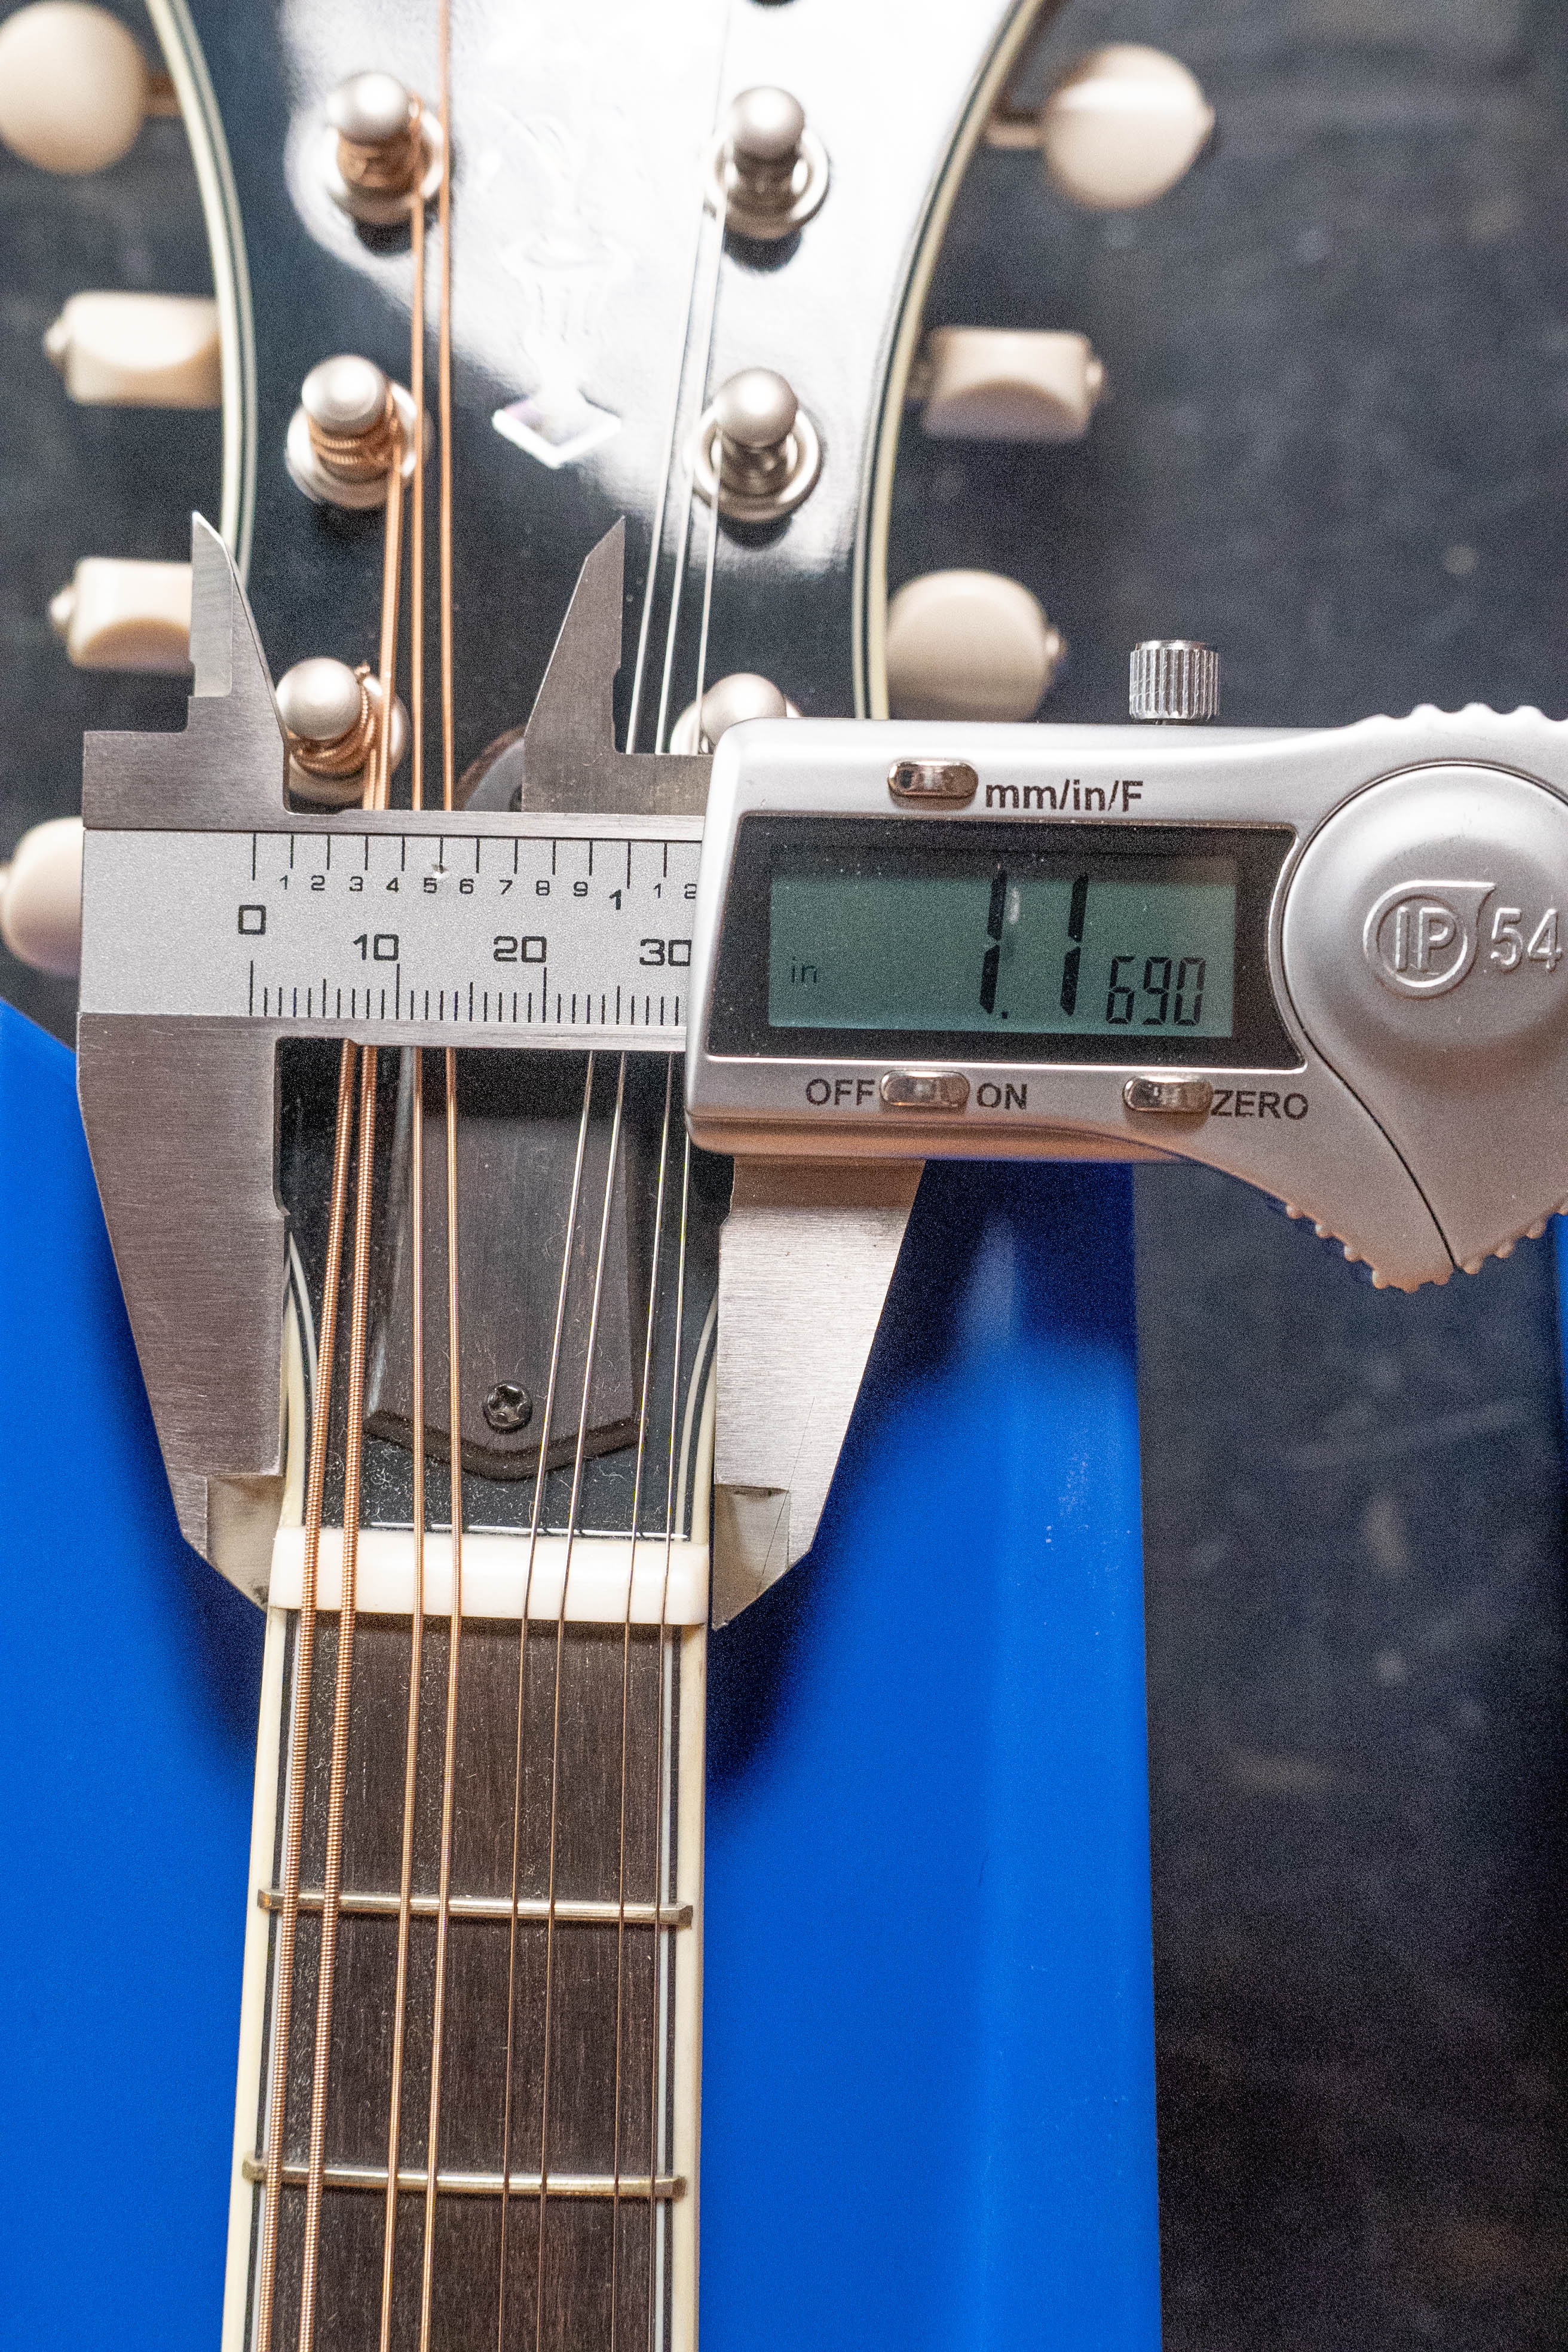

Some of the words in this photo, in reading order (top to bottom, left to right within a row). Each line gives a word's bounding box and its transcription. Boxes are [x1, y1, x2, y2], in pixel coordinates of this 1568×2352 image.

[985, 779, 1144, 813] mm/in/F
[279, 875, 288, 890] 1
[311, 875, 325, 891] 2
[349, 876, 364, 892] 3
[386, 877, 399, 893] 4
[423, 877, 437, 894] 5
[459, 878, 474, 895] 6
[500, 879, 513, 895] 7
[535, 880, 550, 896] 8
[573, 881, 588, 897] 9
[609, 889, 622, 910] 1
[653, 883, 662, 899] 1
[684, 883, 697, 899] 2
[238, 904, 267, 936] 0
[353, 933, 399, 961] 10
[493, 935, 547, 963] 20
[639, 938, 692, 967] 30
[1395, 906, 1457, 973] IP
[1490, 907, 1563, 974] 54
[790, 958, 817, 985] in
[806, 1077, 875, 1107] OFF
[976, 1082, 1028, 1111] ON
[1209, 1089, 1309, 1121] ZERO
